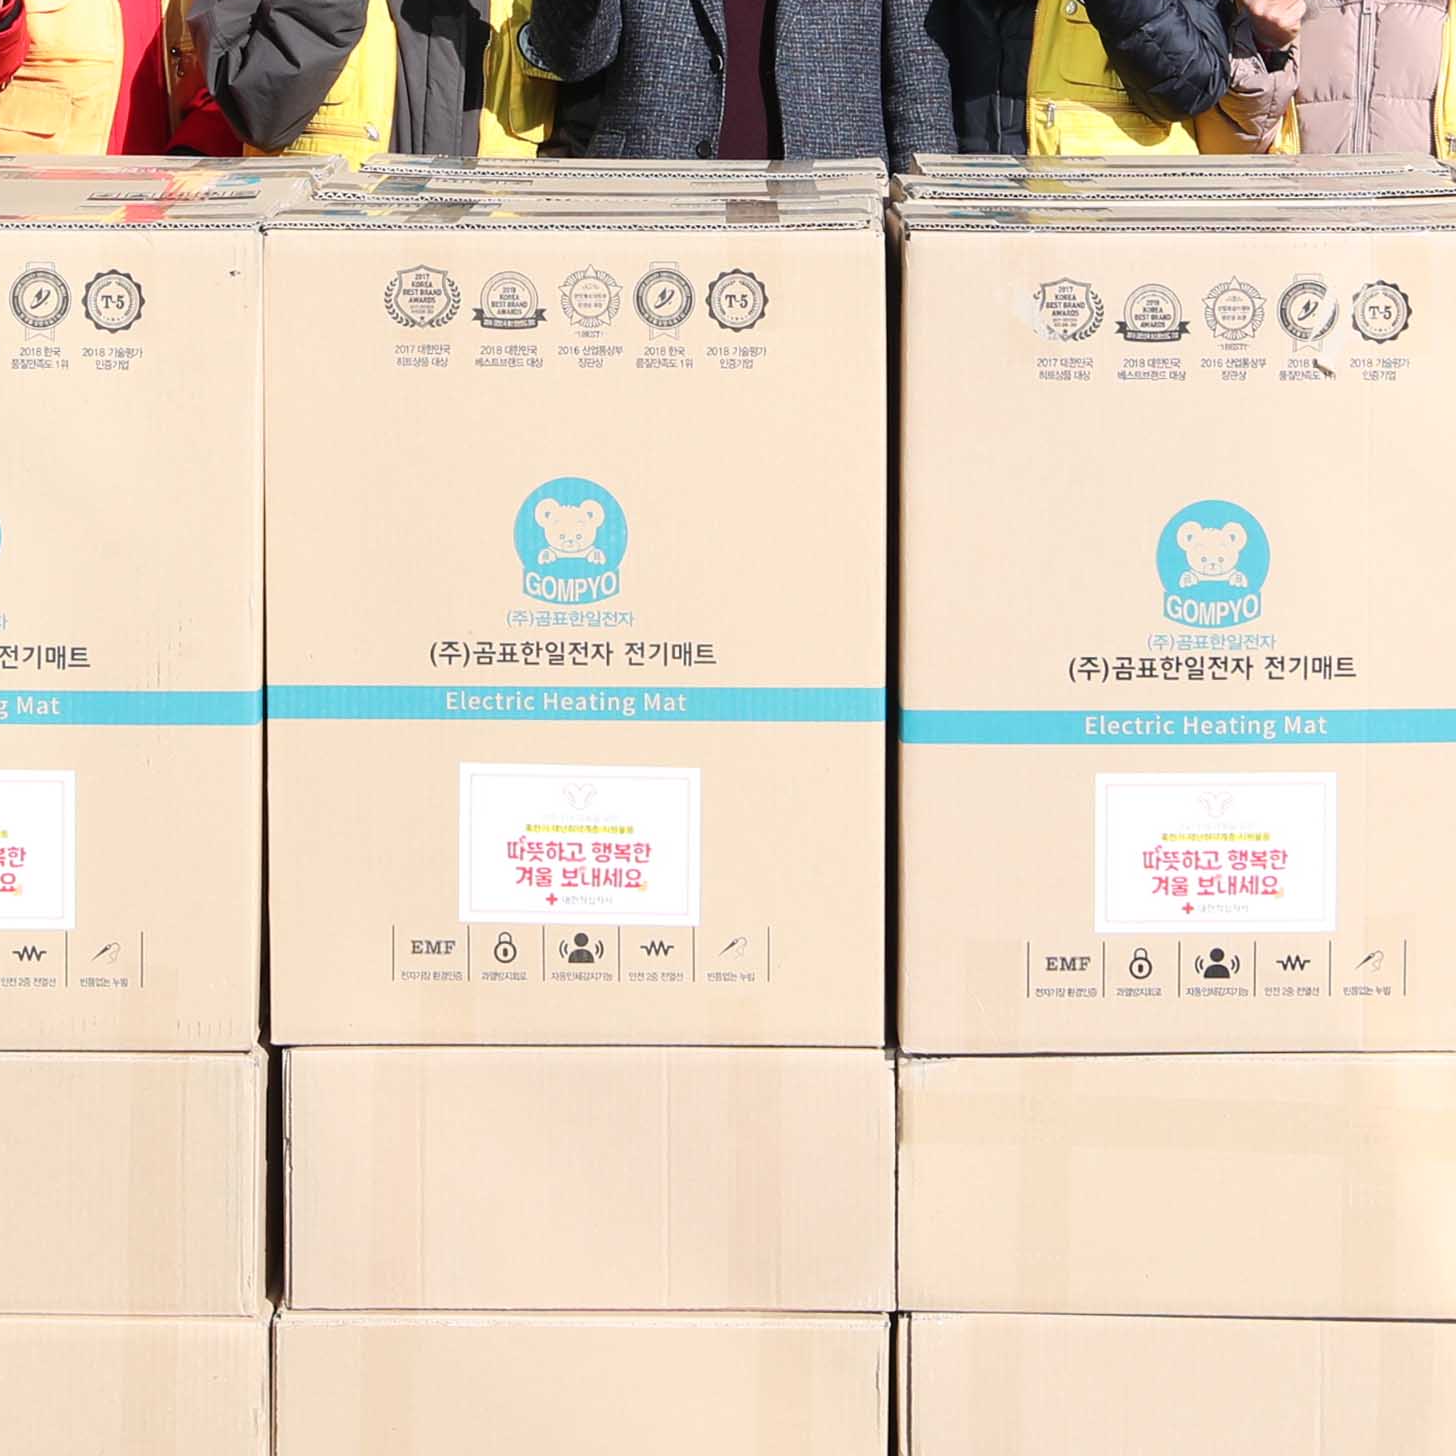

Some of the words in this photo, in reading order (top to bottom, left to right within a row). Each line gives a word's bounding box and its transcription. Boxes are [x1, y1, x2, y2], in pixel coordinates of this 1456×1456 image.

[101, 294, 125, 309] T-5
[724, 294, 748, 308] T-5
[1368, 305, 1392, 320] T-5
[525, 569, 617, 603] GOMPYO
[1166, 592, 1259, 627] GOMPYO
[429, 638, 614, 669] (주)곰표한일전자
[623, 641, 717, 669] 전기매트
[1068, 654, 1254, 684] (주)곰표한일전자
[1263, 655, 1358, 682] 전기매트
[16, 695, 60, 716] Mat
[445, 689, 535, 712] Electric
[542, 691, 636, 715] Heating
[643, 692, 687, 713] Mat
[1084, 714, 1175, 736] Electric
[1182, 715, 1277, 739] Heating
[1284, 715, 1328, 735] Mat
[506, 835, 587, 863] 따뜻하고
[591, 841, 652, 864] 행복한
[1142, 843, 1223, 872] 따뜻하고
[1227, 848, 1288, 871] 행복한
[515, 866, 553, 888] 겨울
[560, 866, 643, 889] 보내세요
[1151, 875, 1189, 897] 겨울
[1196, 874, 1279, 897] 보내세요
[410, 939, 456, 956] EMF
[1044, 956, 1091, 972] EMF
